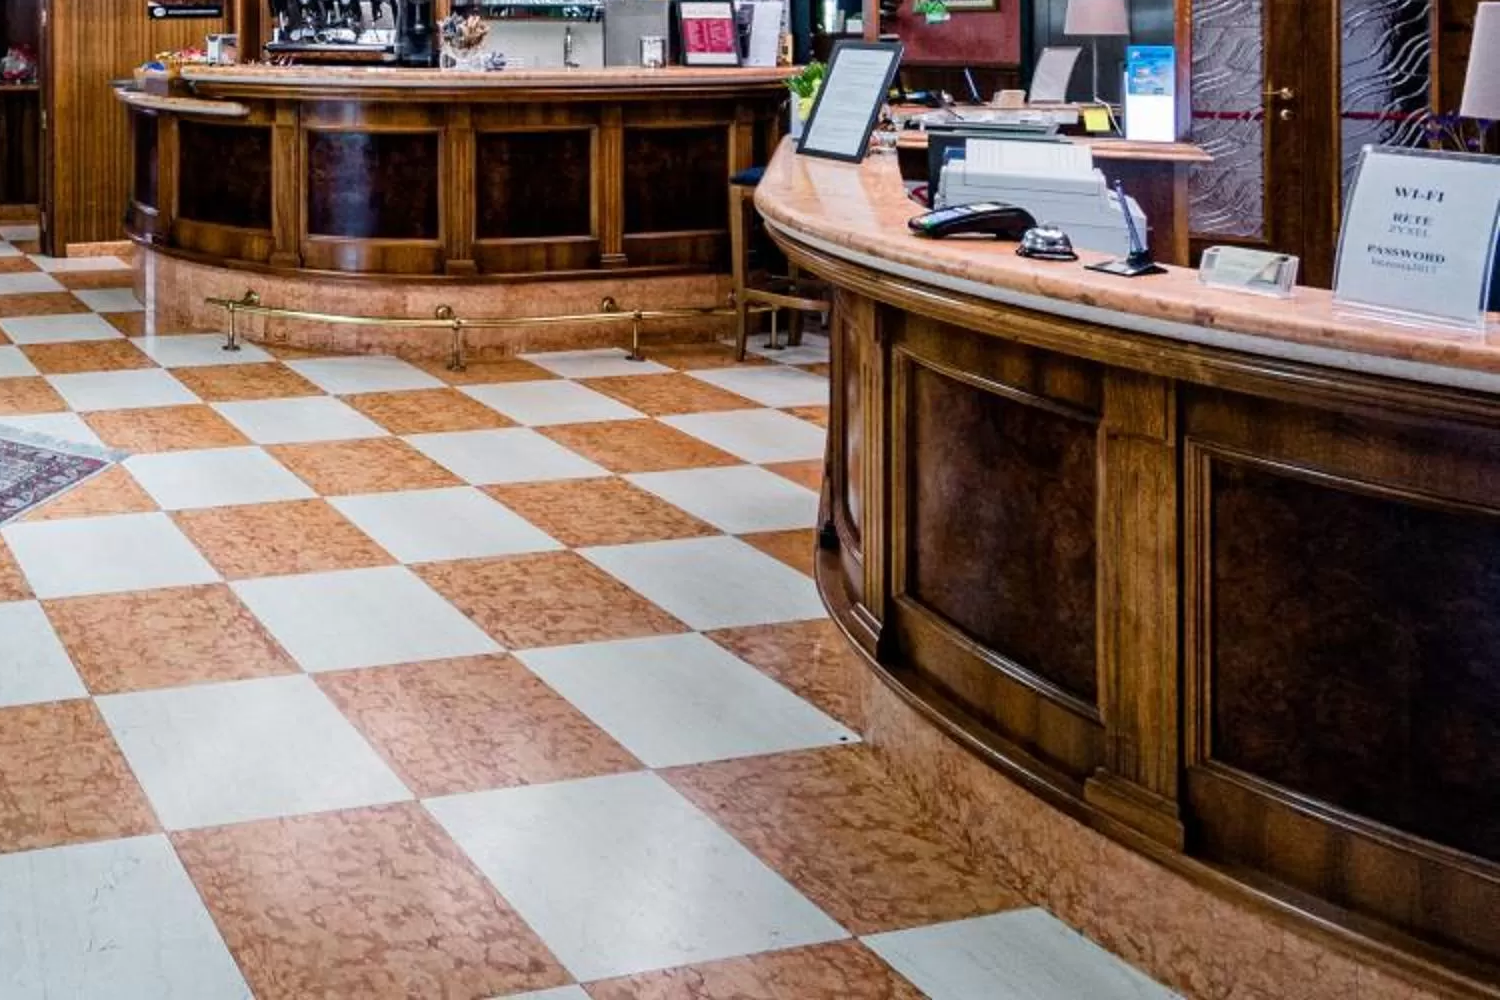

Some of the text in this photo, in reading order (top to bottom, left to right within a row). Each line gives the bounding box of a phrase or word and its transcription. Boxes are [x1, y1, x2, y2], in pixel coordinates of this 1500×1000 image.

[1395, 186, 1444, 203] WI-FI
[1393, 212, 1436, 226] RETE
[1367, 243, 1445, 264] PASSWORD
